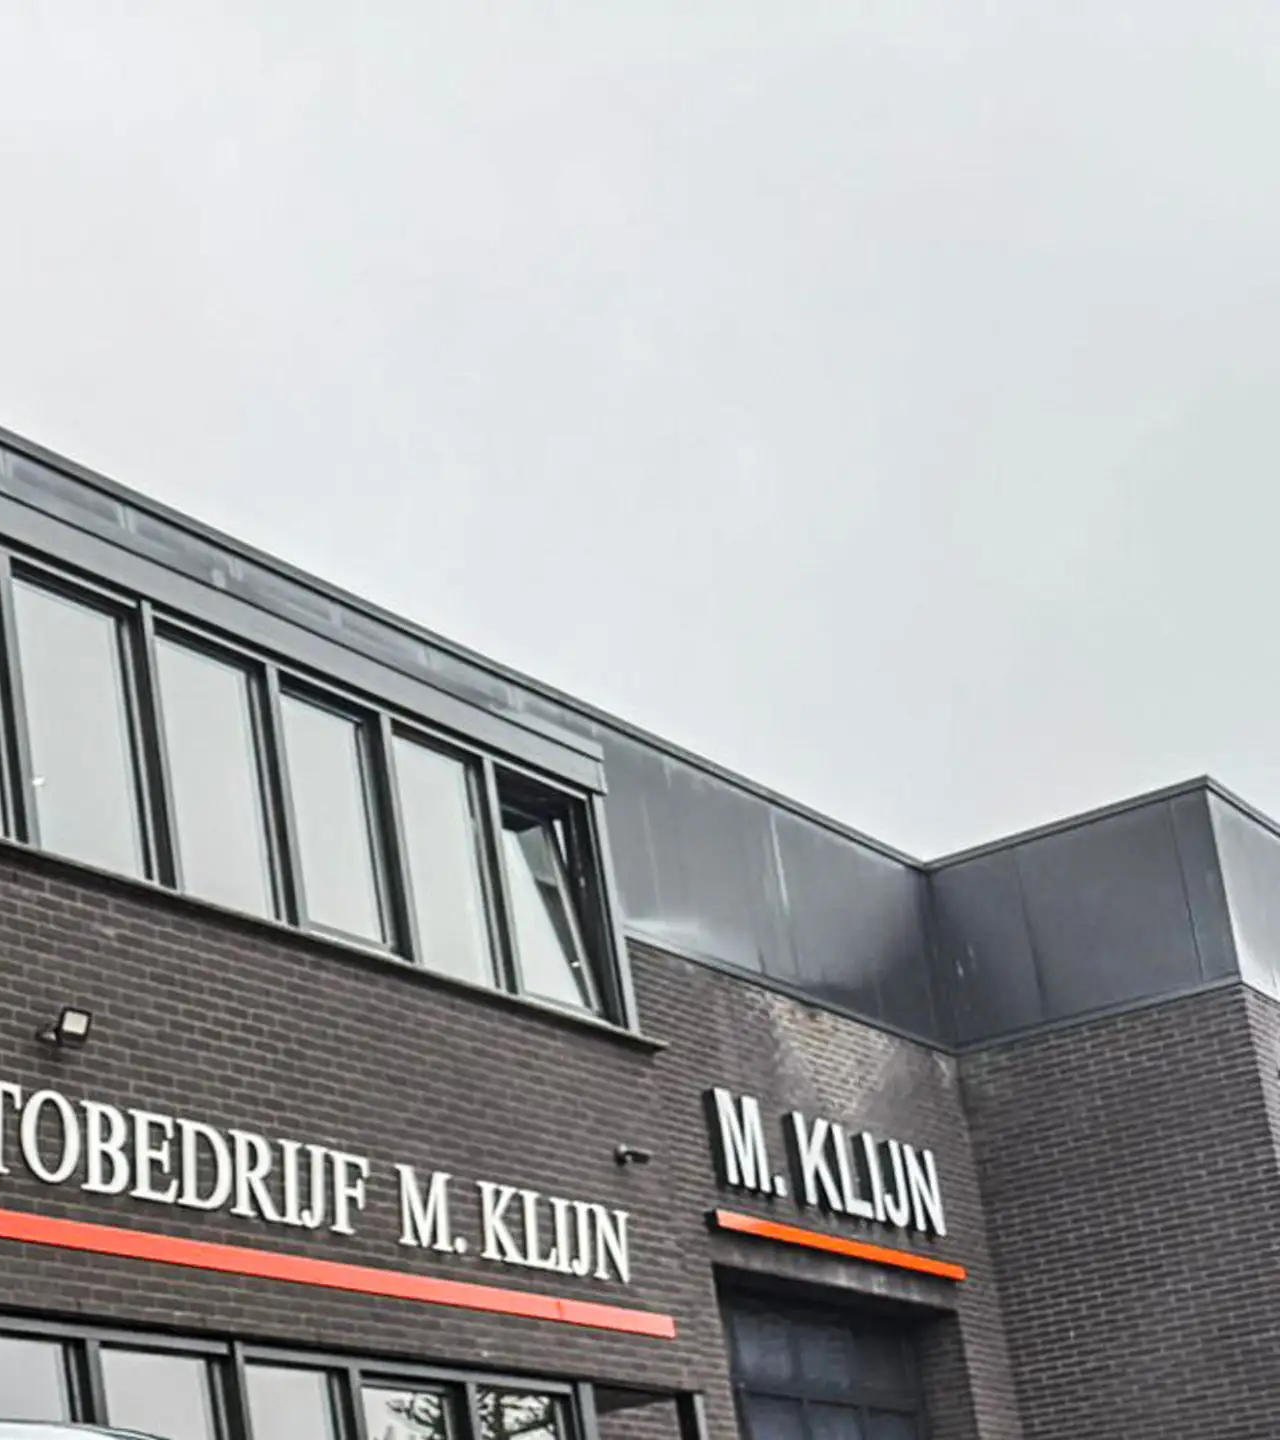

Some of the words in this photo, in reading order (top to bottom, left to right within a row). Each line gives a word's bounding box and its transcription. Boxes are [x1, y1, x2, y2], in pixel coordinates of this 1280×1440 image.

[394, 1163, 468, 1254] M.
[476, 1180, 630, 1284] KLIJN
[712, 1087, 788, 1198] M.
[792, 1110, 948, 1237] KLIJN
